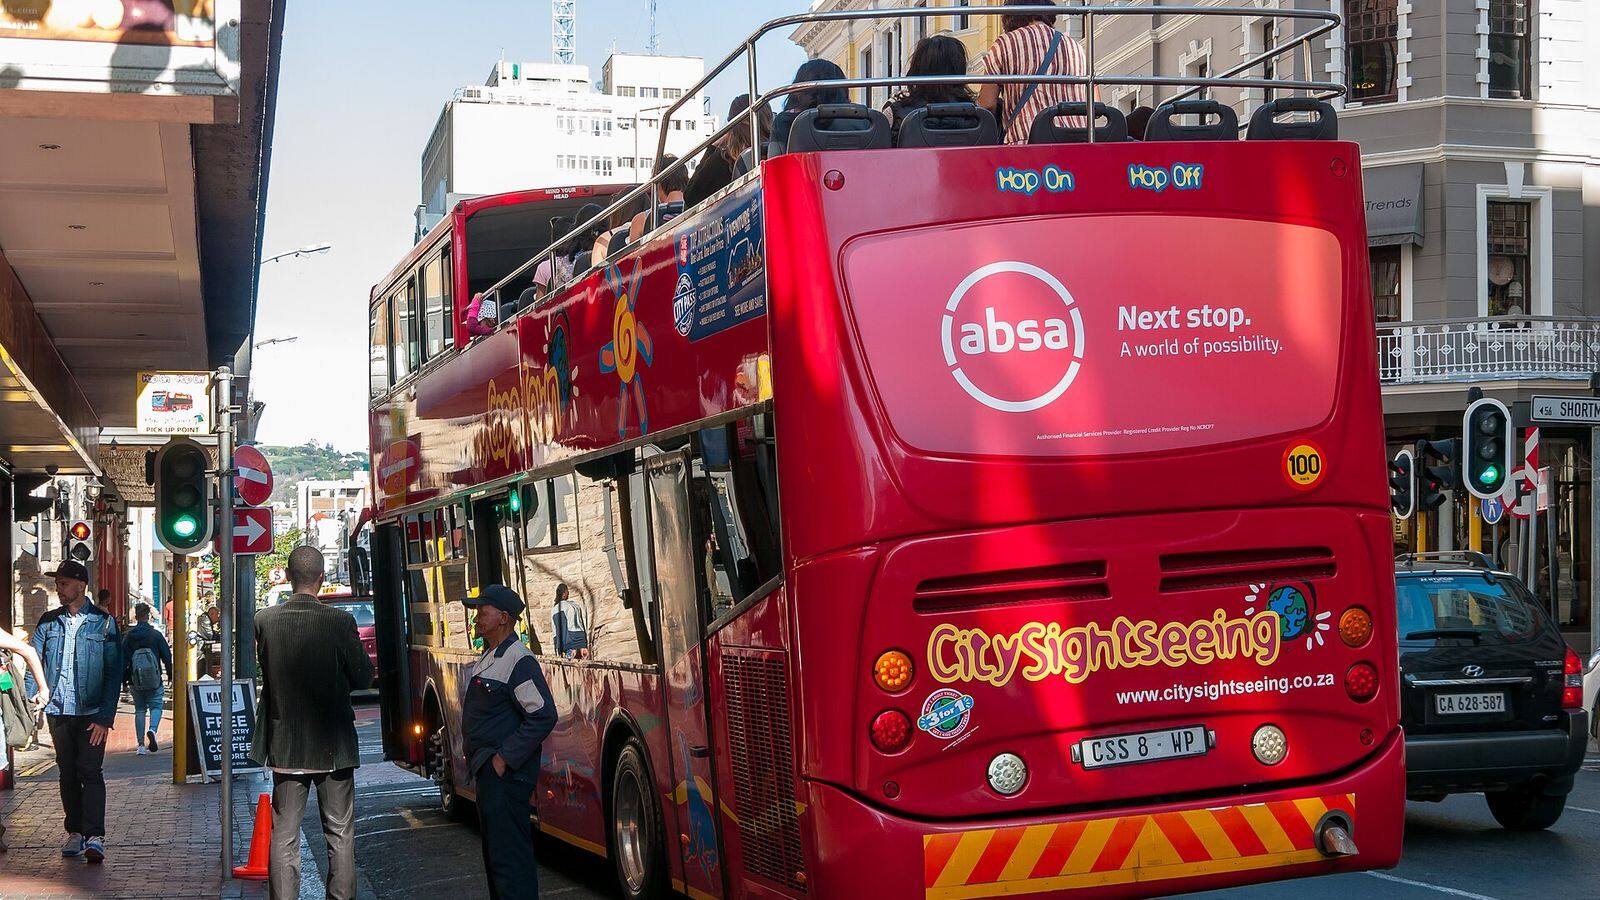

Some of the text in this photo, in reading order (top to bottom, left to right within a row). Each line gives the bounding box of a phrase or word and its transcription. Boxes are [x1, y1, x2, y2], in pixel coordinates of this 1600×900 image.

[997, 165, 1073, 194] Hop On
[1129, 163, 1202, 192] Hop Off
[1365, 197, 1412, 211] Trends
[673, 296, 685, 324] CITY
[684, 291, 696, 312] PASS
[1117, 304, 1251, 333] Next stop.
[960, 306, 1069, 355] absa
[1120, 334, 1283, 358] A world of possibility.
[1544, 406, 1553, 416] 56
[1062, 431, 1082, 439] Financial
[1083, 430, 1102, 438] Services
[1103, 428, 1122, 436] Provider
[1123, 427, 1148, 436] Registered
[1148, 426, 1161, 434] Credit
[1162, 425, 1180, 433] Provider
[1181, 424, 1189, 432] Reg
[1289, 454, 1320, 476] 100
[1116, 673, 1335, 705] www.citysightseeing.co.za
[926, 699, 965, 726] 3 for 1
[1440, 695, 1502, 711] CA 628-587
[209, 743, 252, 753] CFEE
[1092, 738, 1129, 763] CSS
[1138, 736, 1148, 757] 8
[1171, 731, 1194, 753] WP
